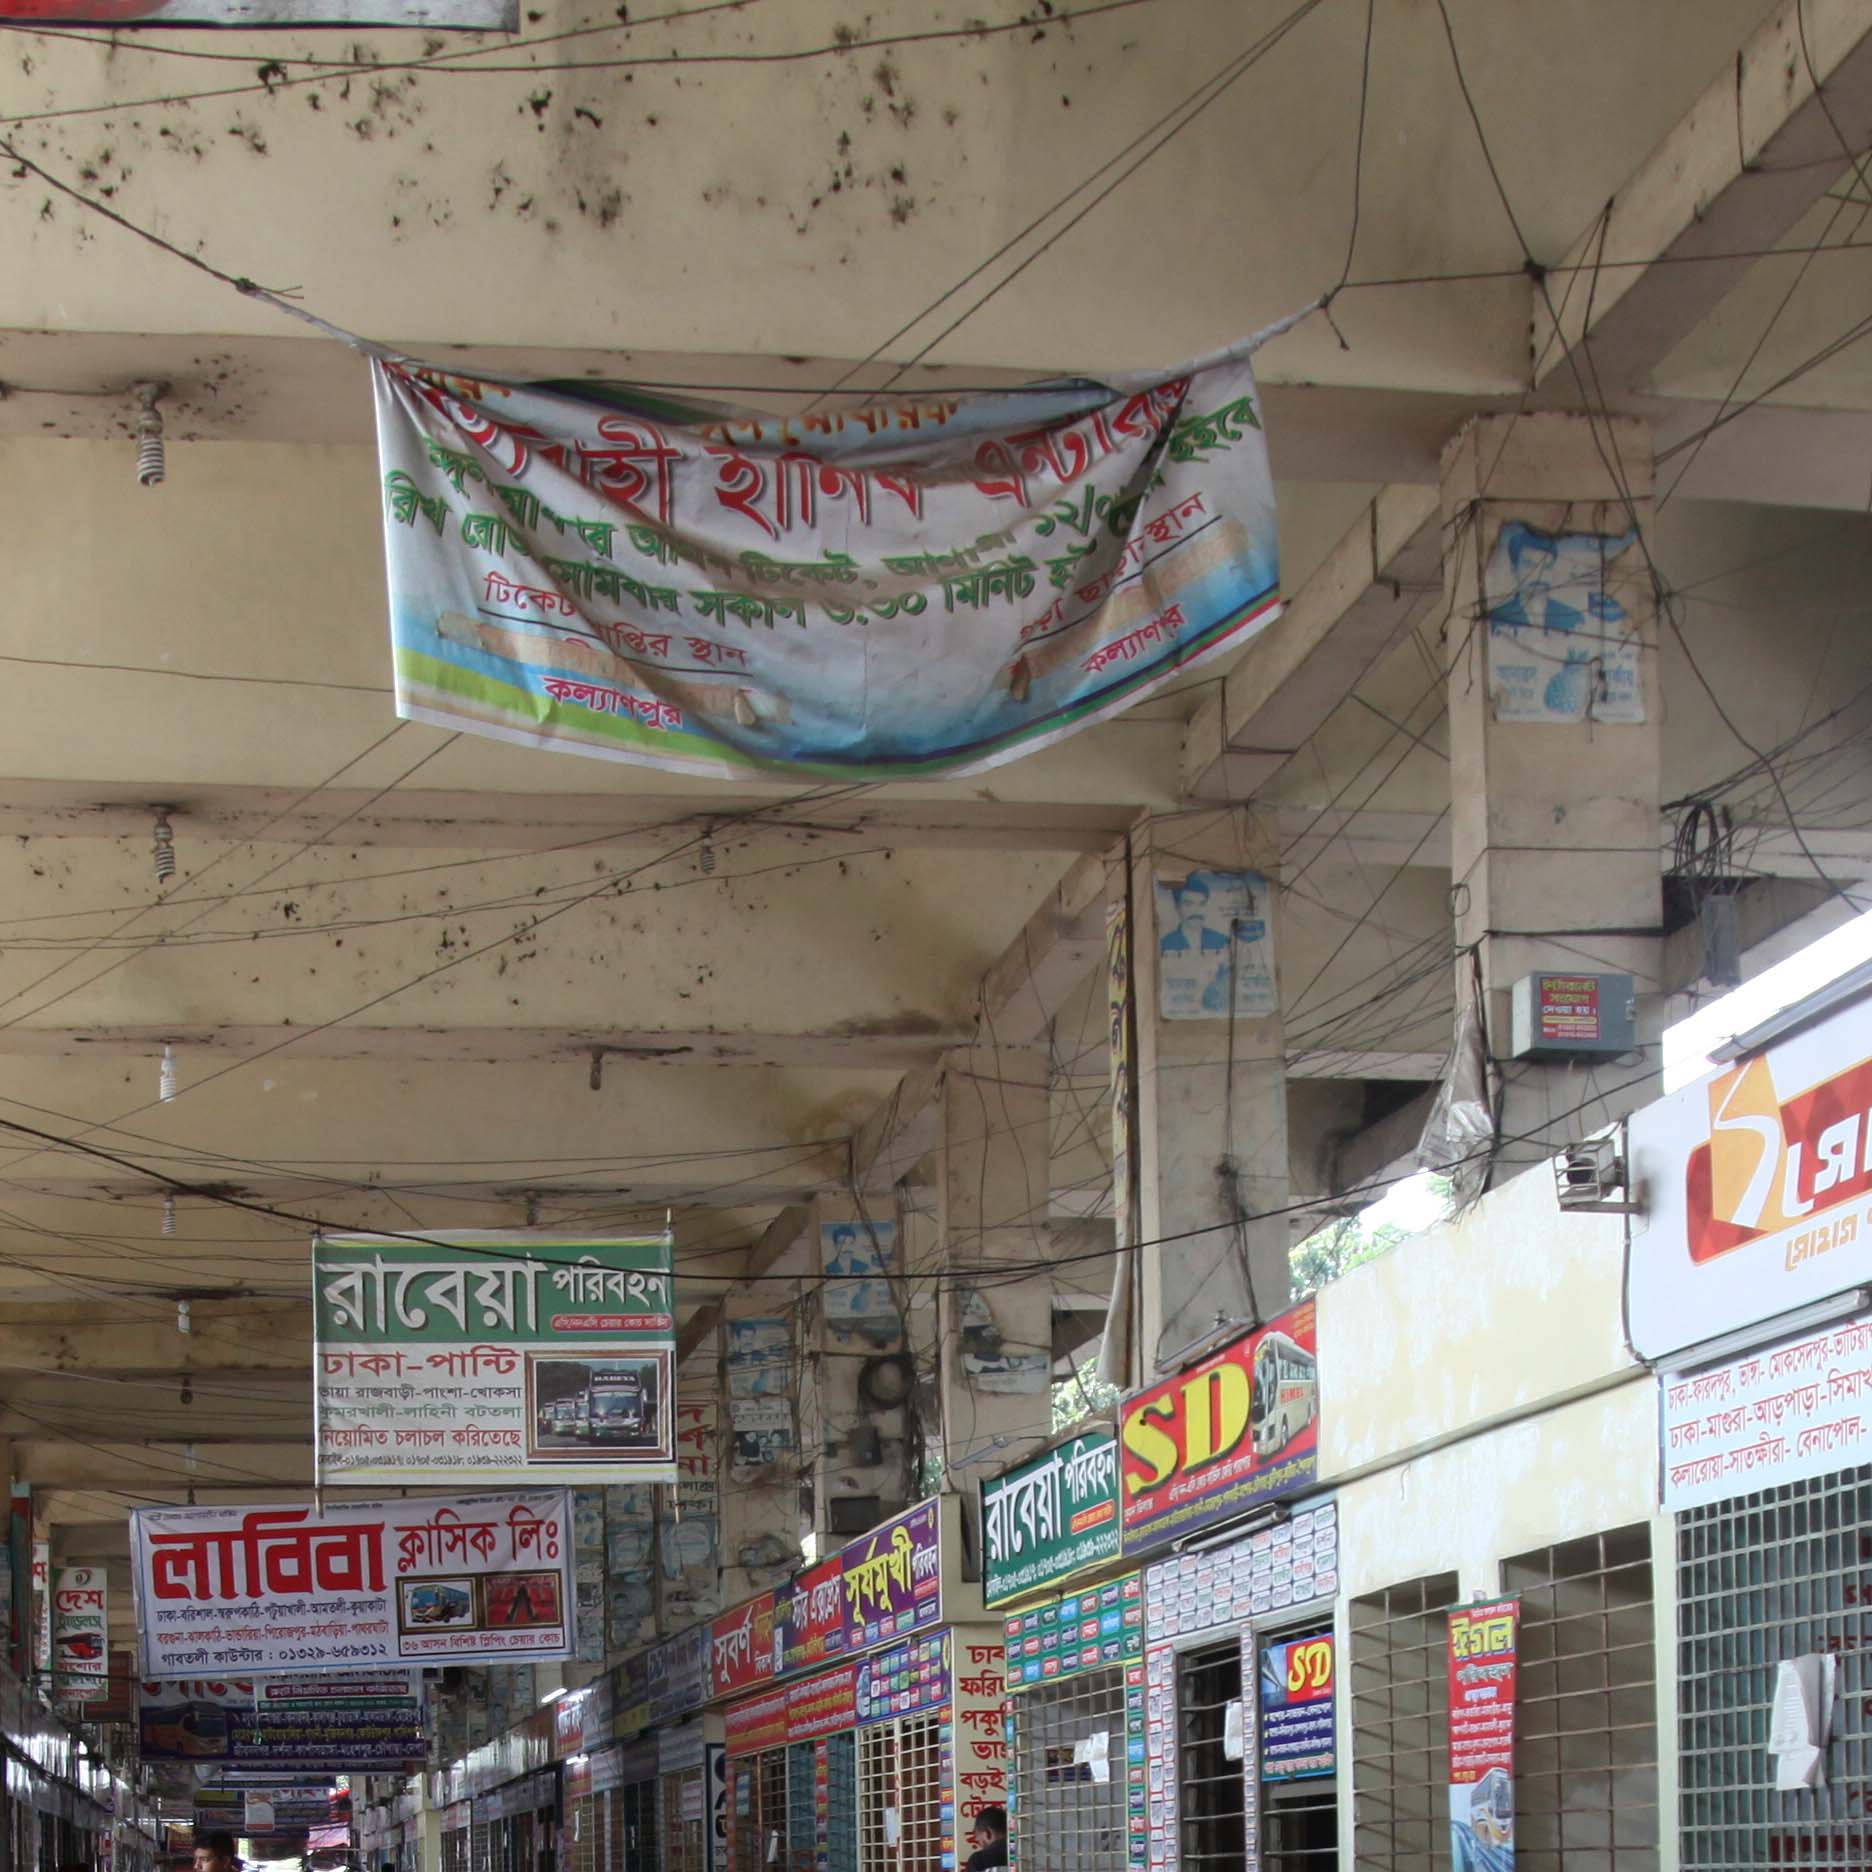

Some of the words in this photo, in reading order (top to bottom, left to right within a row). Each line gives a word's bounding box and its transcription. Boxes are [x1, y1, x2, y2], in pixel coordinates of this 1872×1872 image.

[683, 634, 748, 667] স্থান
[1784, 1214, 1859, 1272] সোহাগ
[316, 1252, 550, 1334] রাবেয়া
[552, 1255, 672, 1308] পরিবহন
[323, 1344, 521, 1378] ঢাকা-পান্টি
[394, 1428, 445, 1448] চলাচল
[451, 1424, 522, 1449] করিতেছে
[1122, 1362, 1252, 1501] SD
[984, 1449, 1064, 1563] রাবেয়া
[1065, 1440, 1118, 1504] পরিবহন
[149, 1509, 388, 1601] লাবিবা
[393, 1508, 499, 1573] ক্লাসিক
[507, 1504, 559, 1562] লিঃ
[56, 1588, 104, 1612] দেশ
[160, 1648, 209, 1668] গাবতলী
[213, 1645, 263, 1666] কাউন্টার
[1450, 1614, 1516, 1662] ঈগল
[1288, 1641, 1332, 1692] SD
